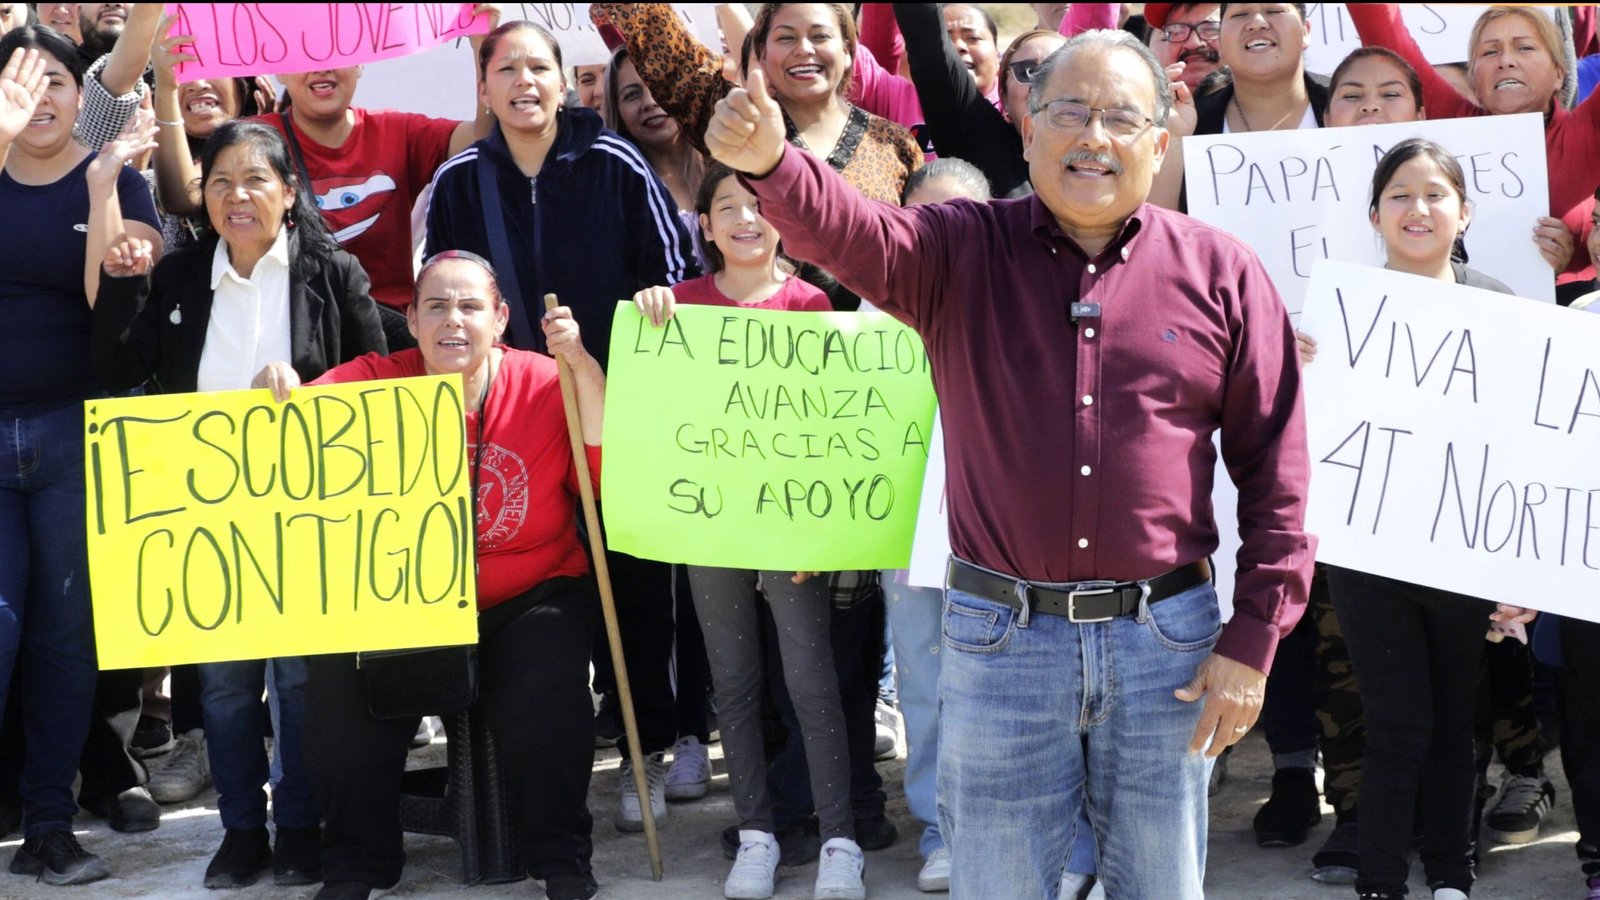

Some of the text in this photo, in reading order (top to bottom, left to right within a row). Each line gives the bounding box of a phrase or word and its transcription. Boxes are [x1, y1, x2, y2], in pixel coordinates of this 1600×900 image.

[211, 3, 288, 66] LOS
[1206, 144, 1342, 206] PAPÁ
[634, 313, 927, 375] LA EDUCACIO
[1336, 287, 1600, 434] VIVA LA
[725, 381, 895, 421] AVANZA
[675, 421, 929, 461] GRACIAS A
[667, 473, 895, 521] SU APOYO
[1320, 420, 1600, 570] 4T NORTE
[137, 495, 469, 637] CONTIGO!
